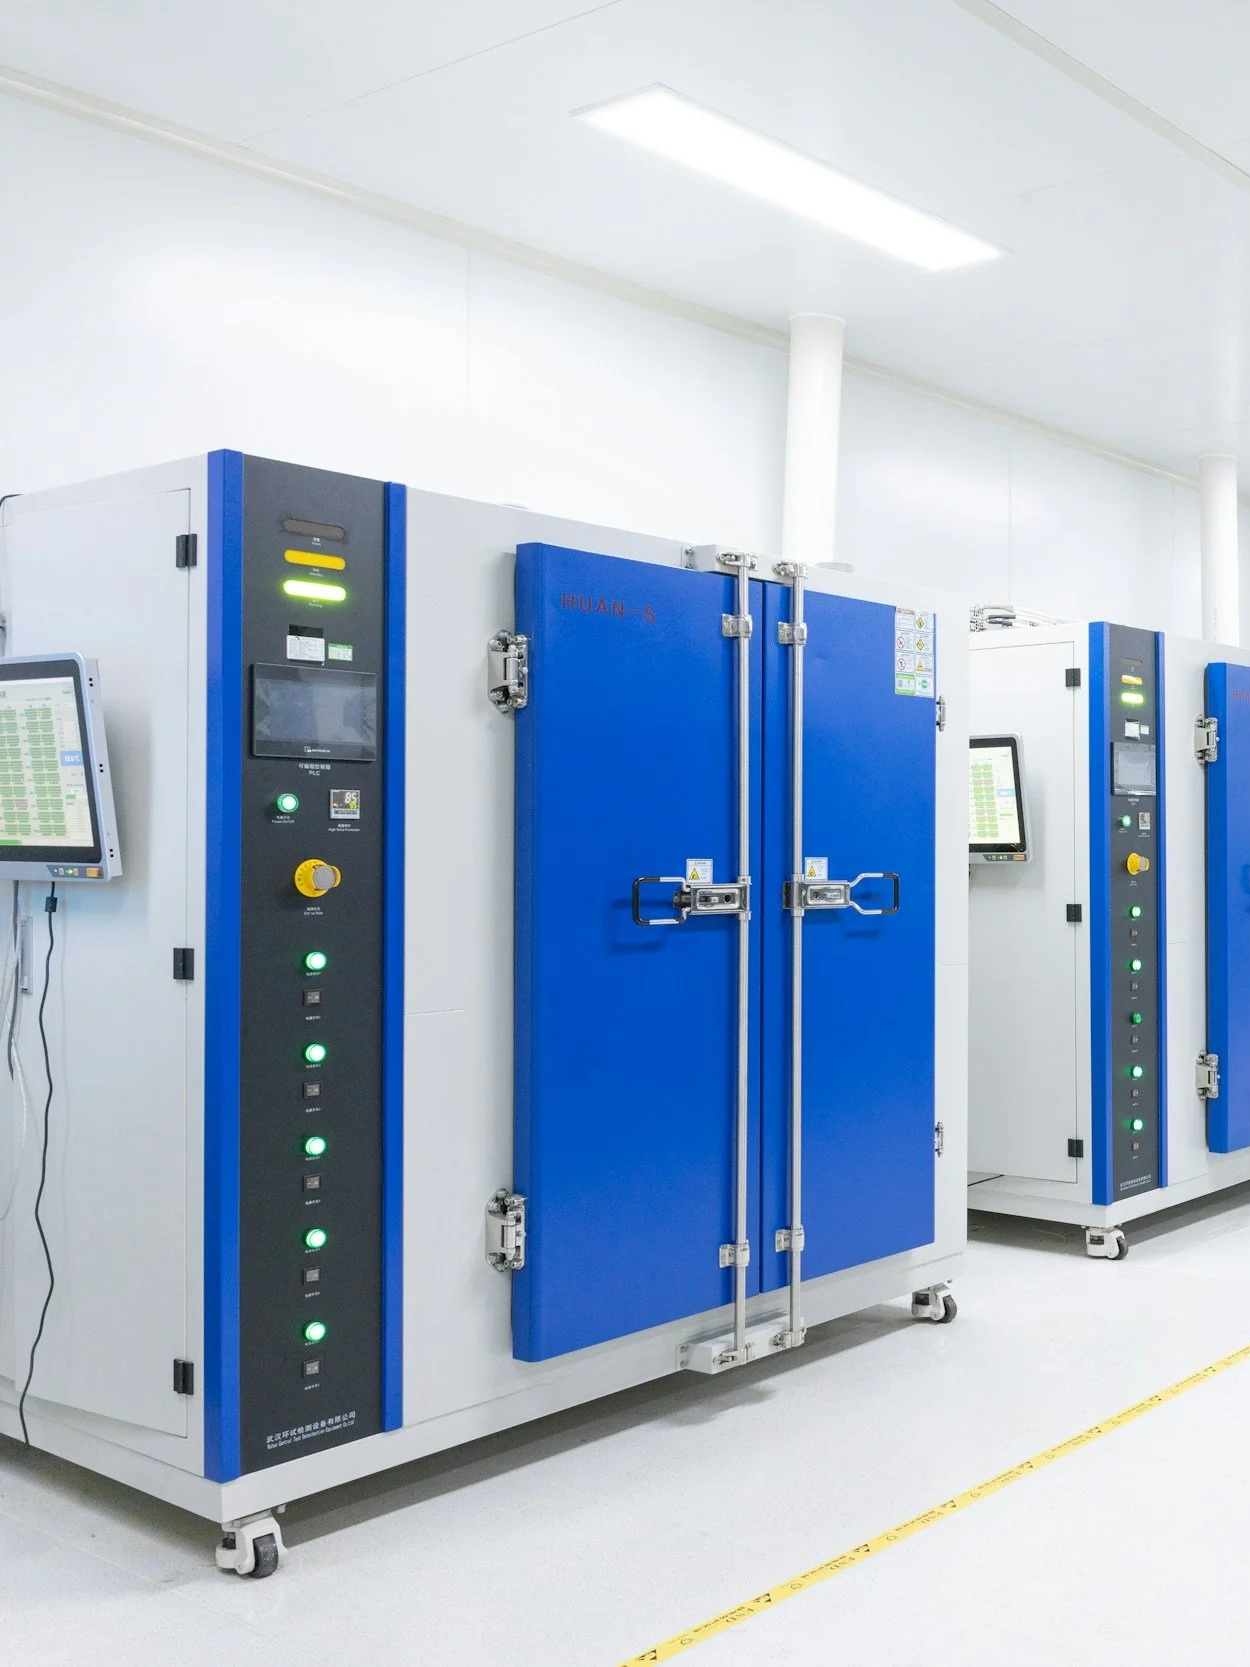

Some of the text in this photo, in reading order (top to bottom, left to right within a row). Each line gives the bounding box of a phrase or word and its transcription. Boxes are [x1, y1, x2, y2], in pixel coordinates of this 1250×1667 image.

[561, 592, 656, 623] HUAN-S
[344, 792, 357, 804] 85
[829, 1556, 855, 1570] ESD
[725, 1607, 755, 1623] ESD
